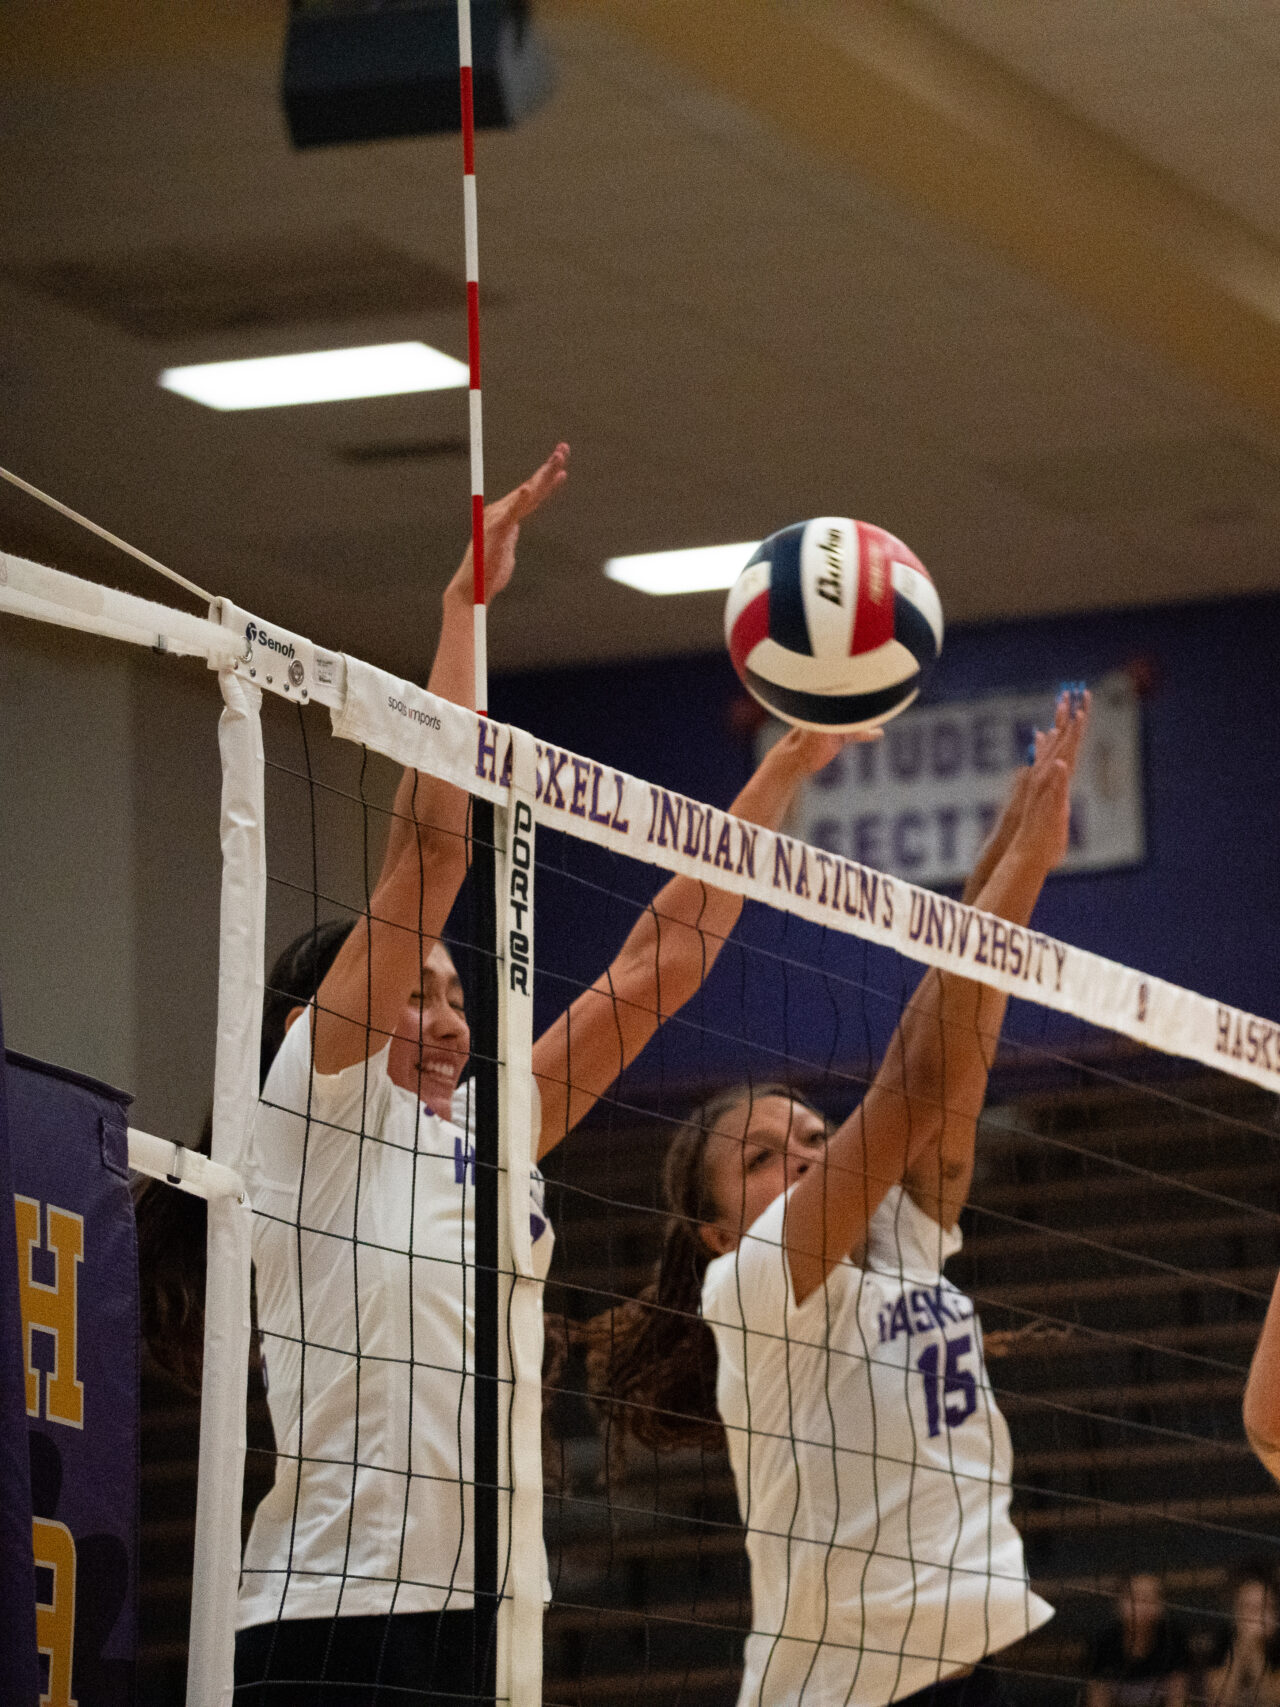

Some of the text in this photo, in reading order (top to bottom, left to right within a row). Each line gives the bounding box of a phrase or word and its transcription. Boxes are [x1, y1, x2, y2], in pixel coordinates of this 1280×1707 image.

[258, 630, 296, 659] Senoh
[812, 711, 1036, 788] TUDE
[510, 800, 533, 997] PORTER
[647, 787, 758, 880] INDIAN
[773, 836, 895, 929] NATIONS
[910, 889, 1066, 991] UNIVERSITY
[918, 1334, 977, 1438] 15
